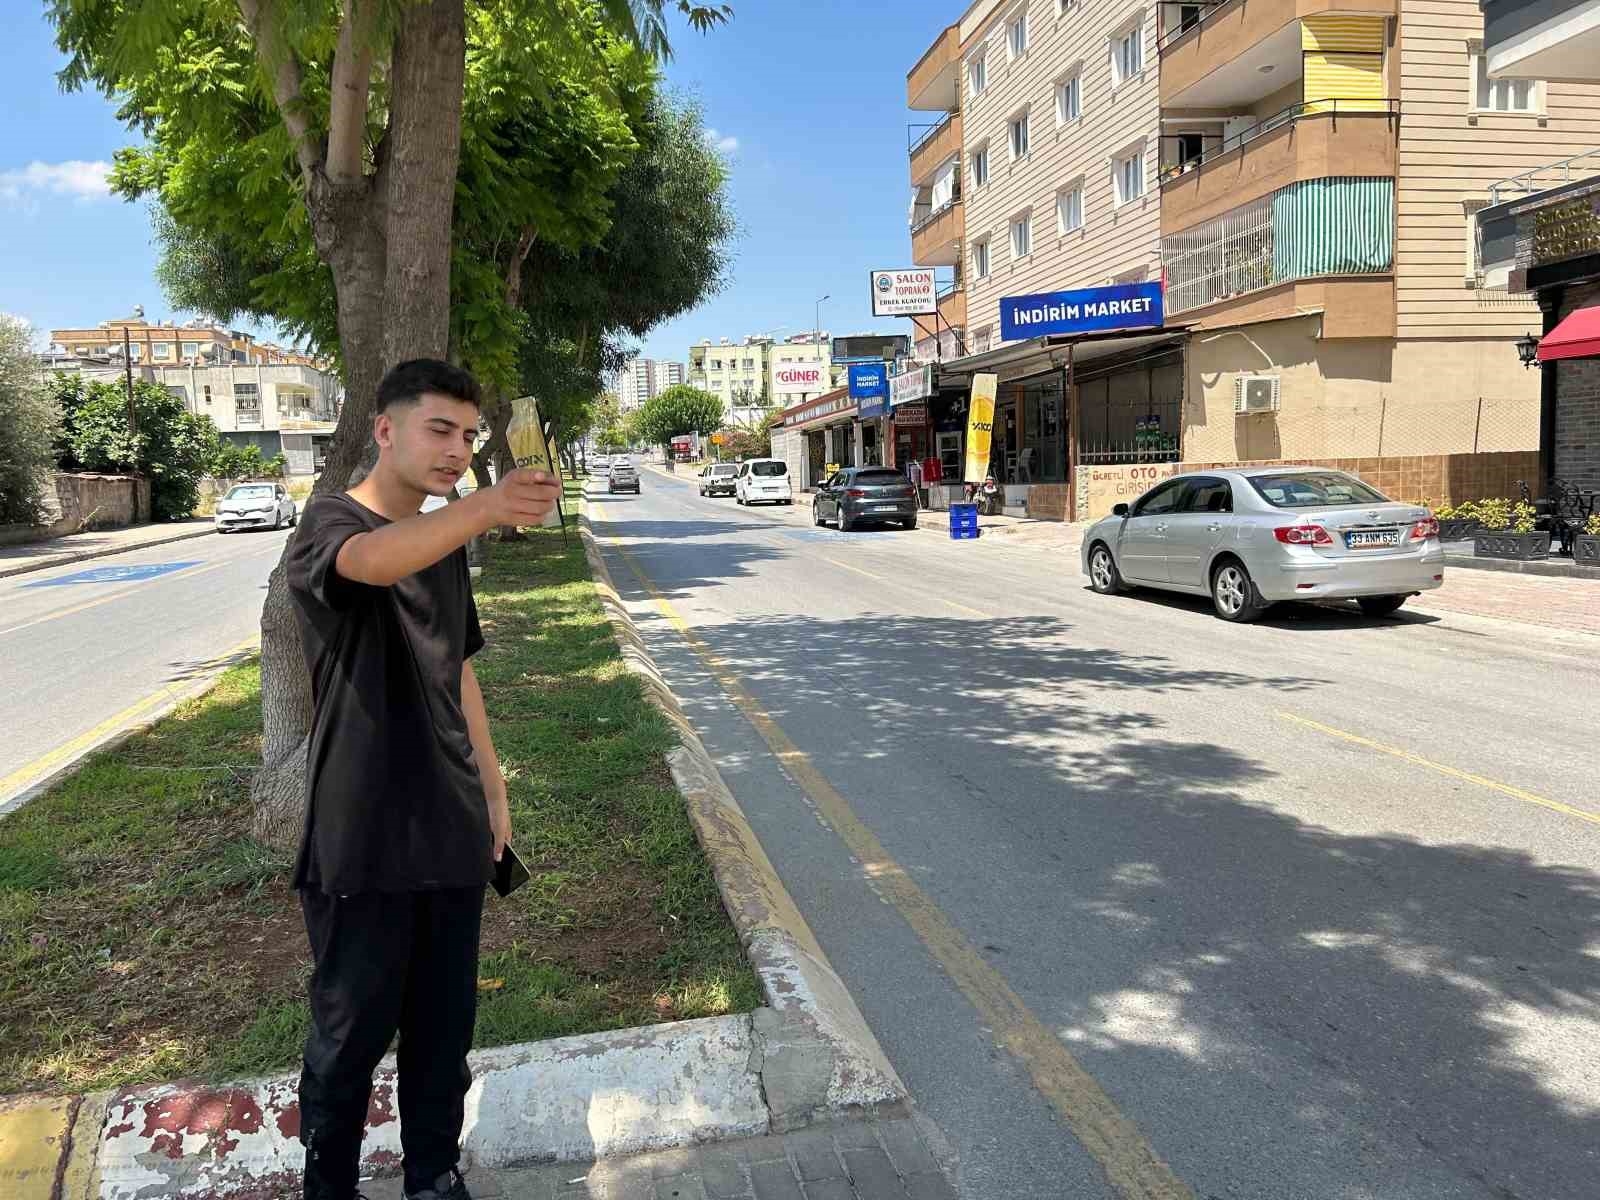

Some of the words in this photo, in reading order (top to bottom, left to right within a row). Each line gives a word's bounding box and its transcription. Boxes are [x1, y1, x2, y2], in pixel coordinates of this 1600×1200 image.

[896, 273, 931, 284] SALON
[1013, 302, 1079, 325] İNDİRİM
[1085, 297, 1152, 318] MARKET
[781, 369, 820, 382] GÜNER
[1130, 466, 1157, 480] OTO
[1352, 533, 1363, 544] 33
[1382, 532, 1398, 543] 635
